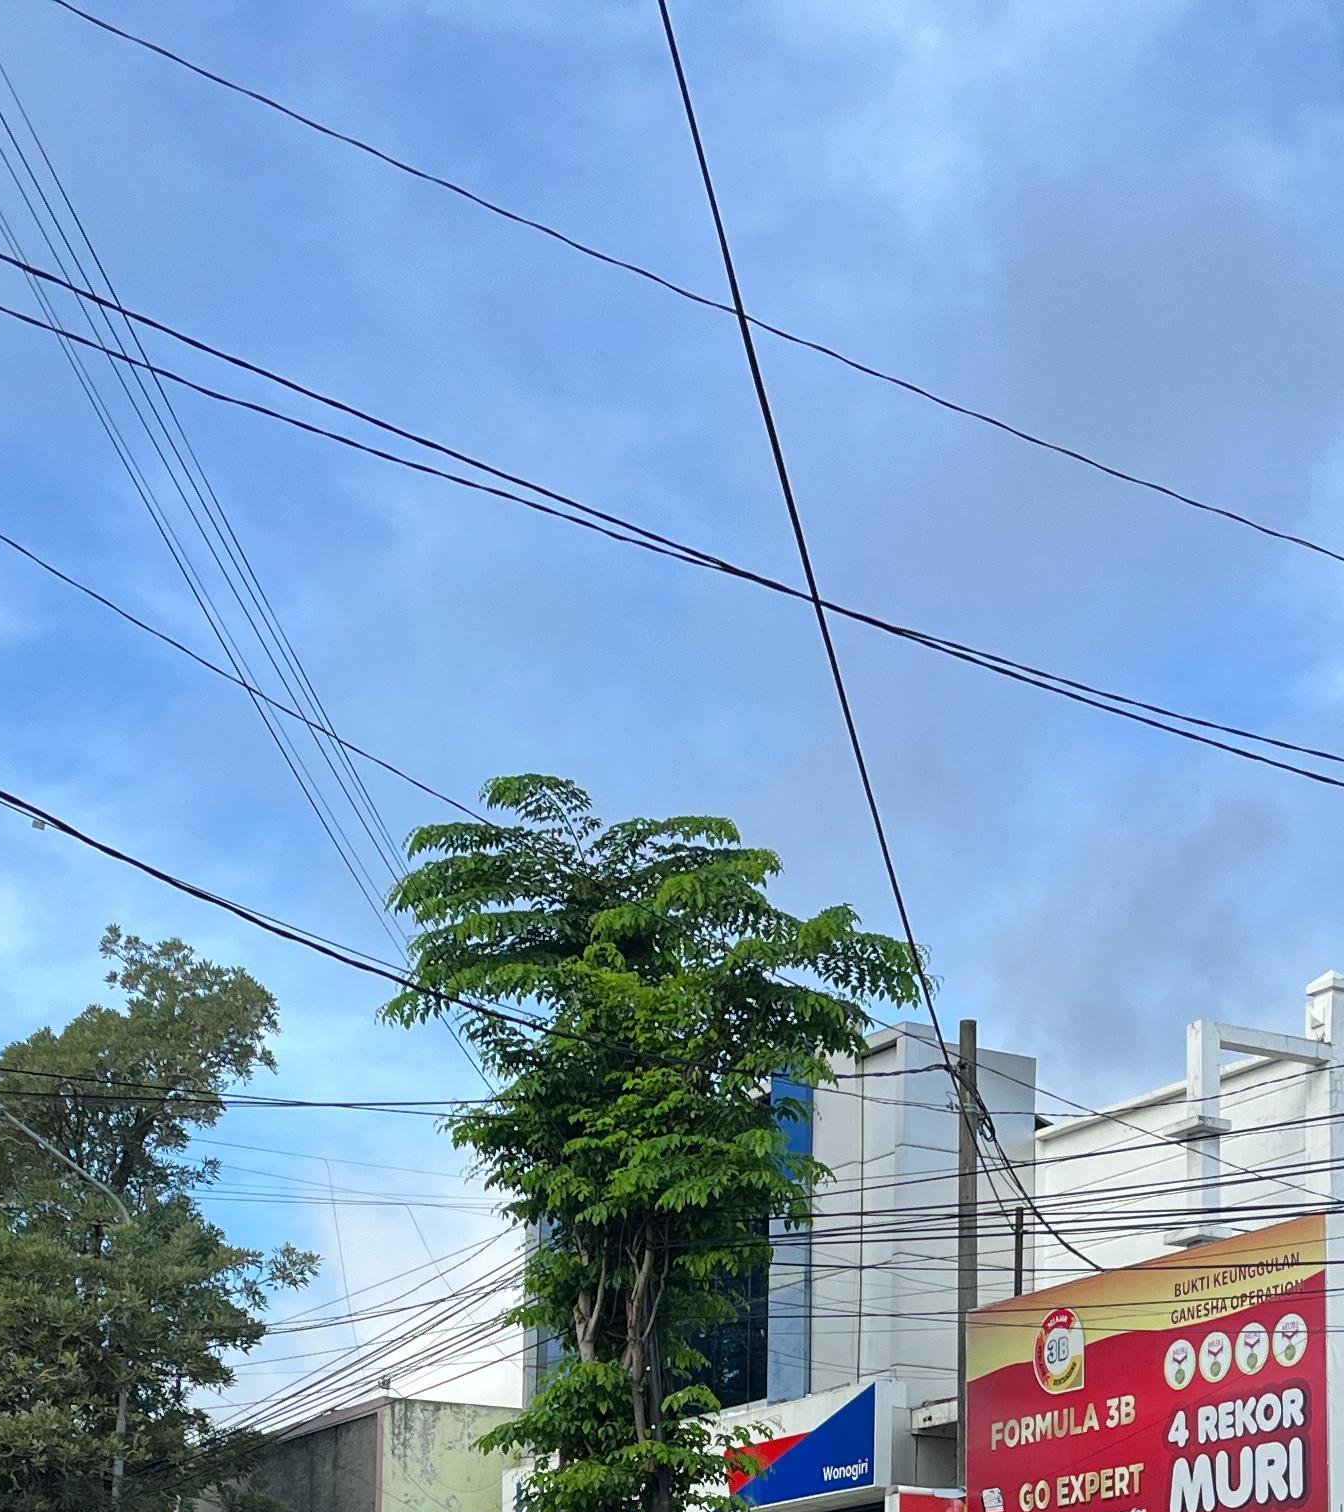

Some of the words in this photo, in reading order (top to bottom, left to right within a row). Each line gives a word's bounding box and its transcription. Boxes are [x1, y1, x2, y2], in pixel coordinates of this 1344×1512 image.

[1174, 1275, 1210, 1298] BUKTI
[1213, 1252, 1301, 1287] KEUNGGULAN
[1171, 1297, 1227, 1325] GANESHA
[1230, 1278, 1305, 1311] OPERATION
[1047, 1335, 1069, 1364] 3B
[990, 1402, 1100, 1451] FORMULA
[1106, 1394, 1136, 1429] 3B
[1167, 1410, 1190, 1448] 4
[1198, 1387, 1305, 1445] REKOR
[822, 1458, 869, 1482] Wonogiri
[1018, 1479, 1051, 1512] GO
[1057, 1462, 1145, 1508] EXPERT
